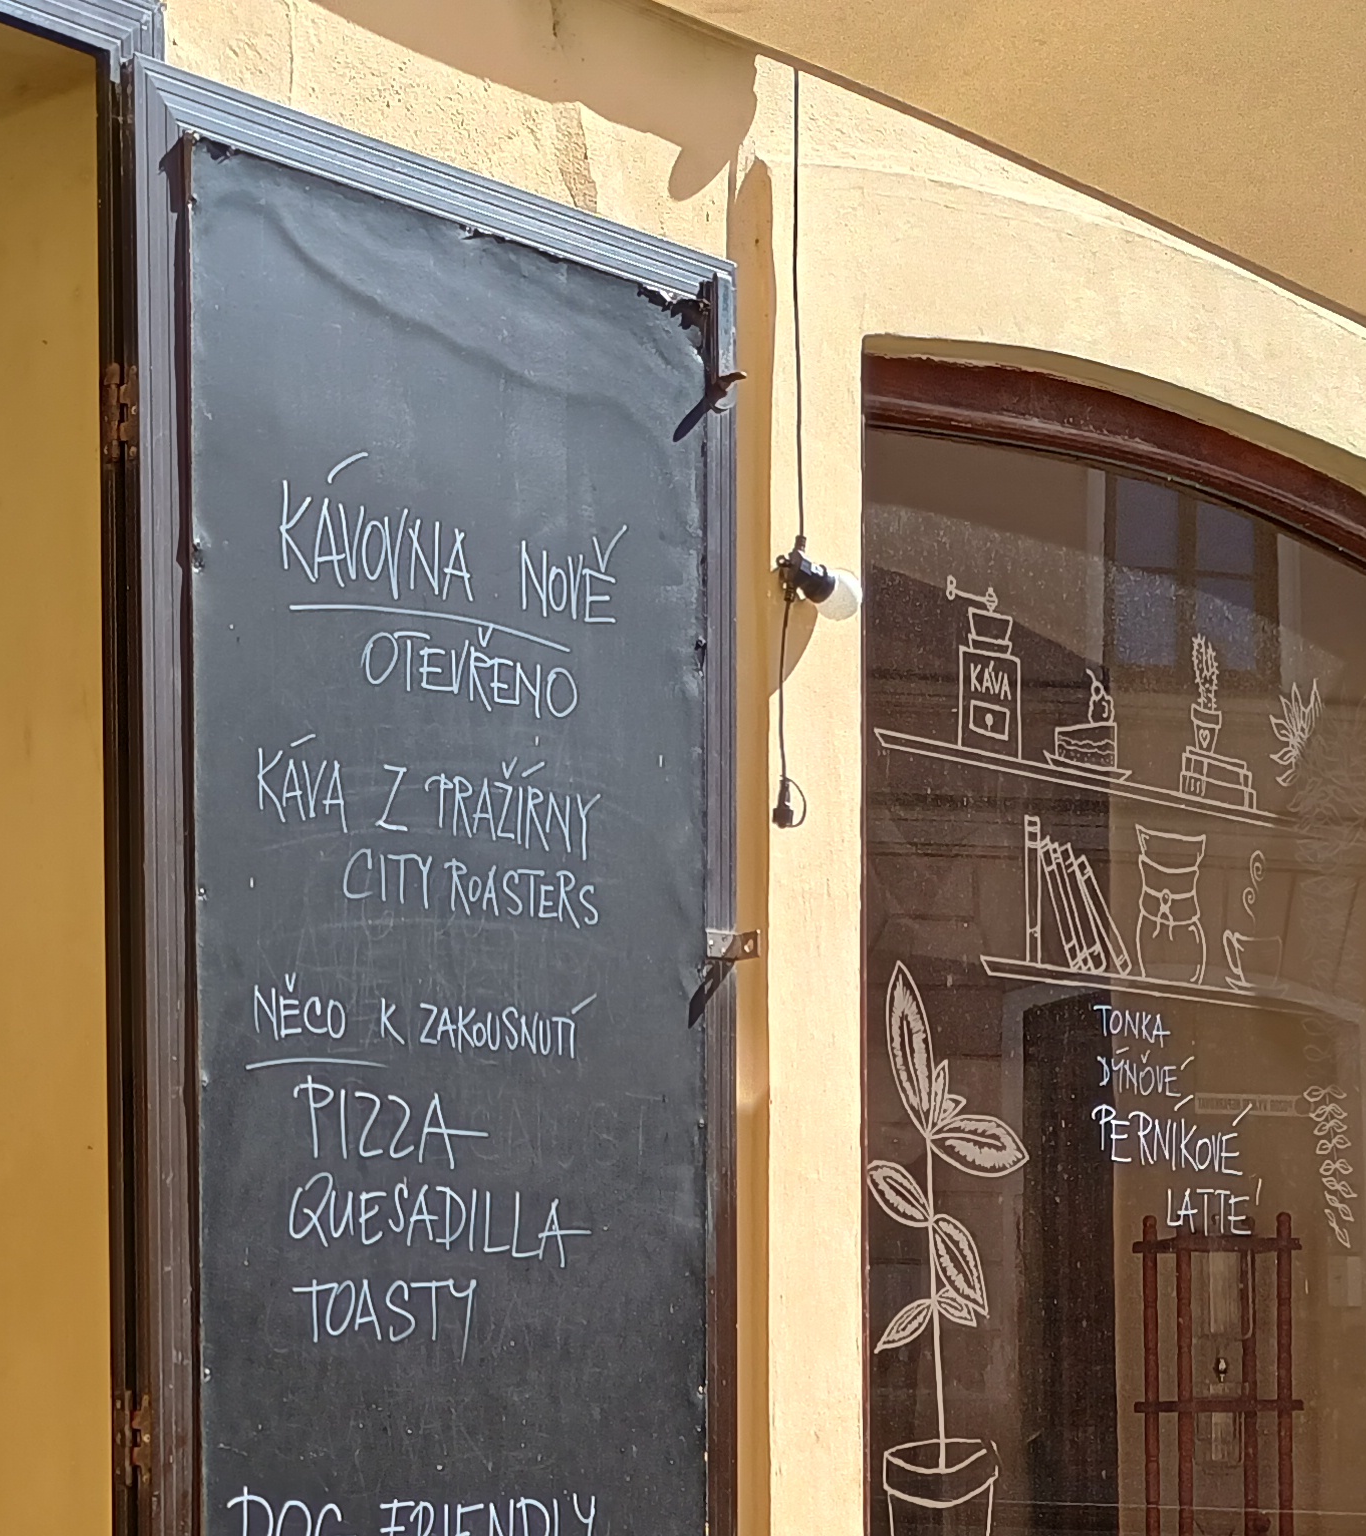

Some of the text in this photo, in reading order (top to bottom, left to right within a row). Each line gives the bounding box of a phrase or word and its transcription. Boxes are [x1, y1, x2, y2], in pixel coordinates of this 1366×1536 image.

[279, 451, 627, 623] KÁVOVNA NOVĚ
[361, 625, 577, 718] OTEVŘENO
[970, 660, 1011, 700] KÁVA
[257, 733, 601, 860] KÁVA Z PRAŽÍRNY
[343, 849, 598, 928] CITY ROASTERS
[253, 973, 598, 1059] NĚCO K ZAKOUSNUTÍ
[1093, 1005, 1171, 1048] TONKA
[1097, 1047, 1194, 1096] DÝŇOVÉ
[293, 1075, 489, 1169] PIZZA
[1091, 1094, 1252, 1175] PERNÍKOVÉ
[288, 1172, 592, 1268] QUESADILLA
[292, 1279, 477, 1366] TOASTY
